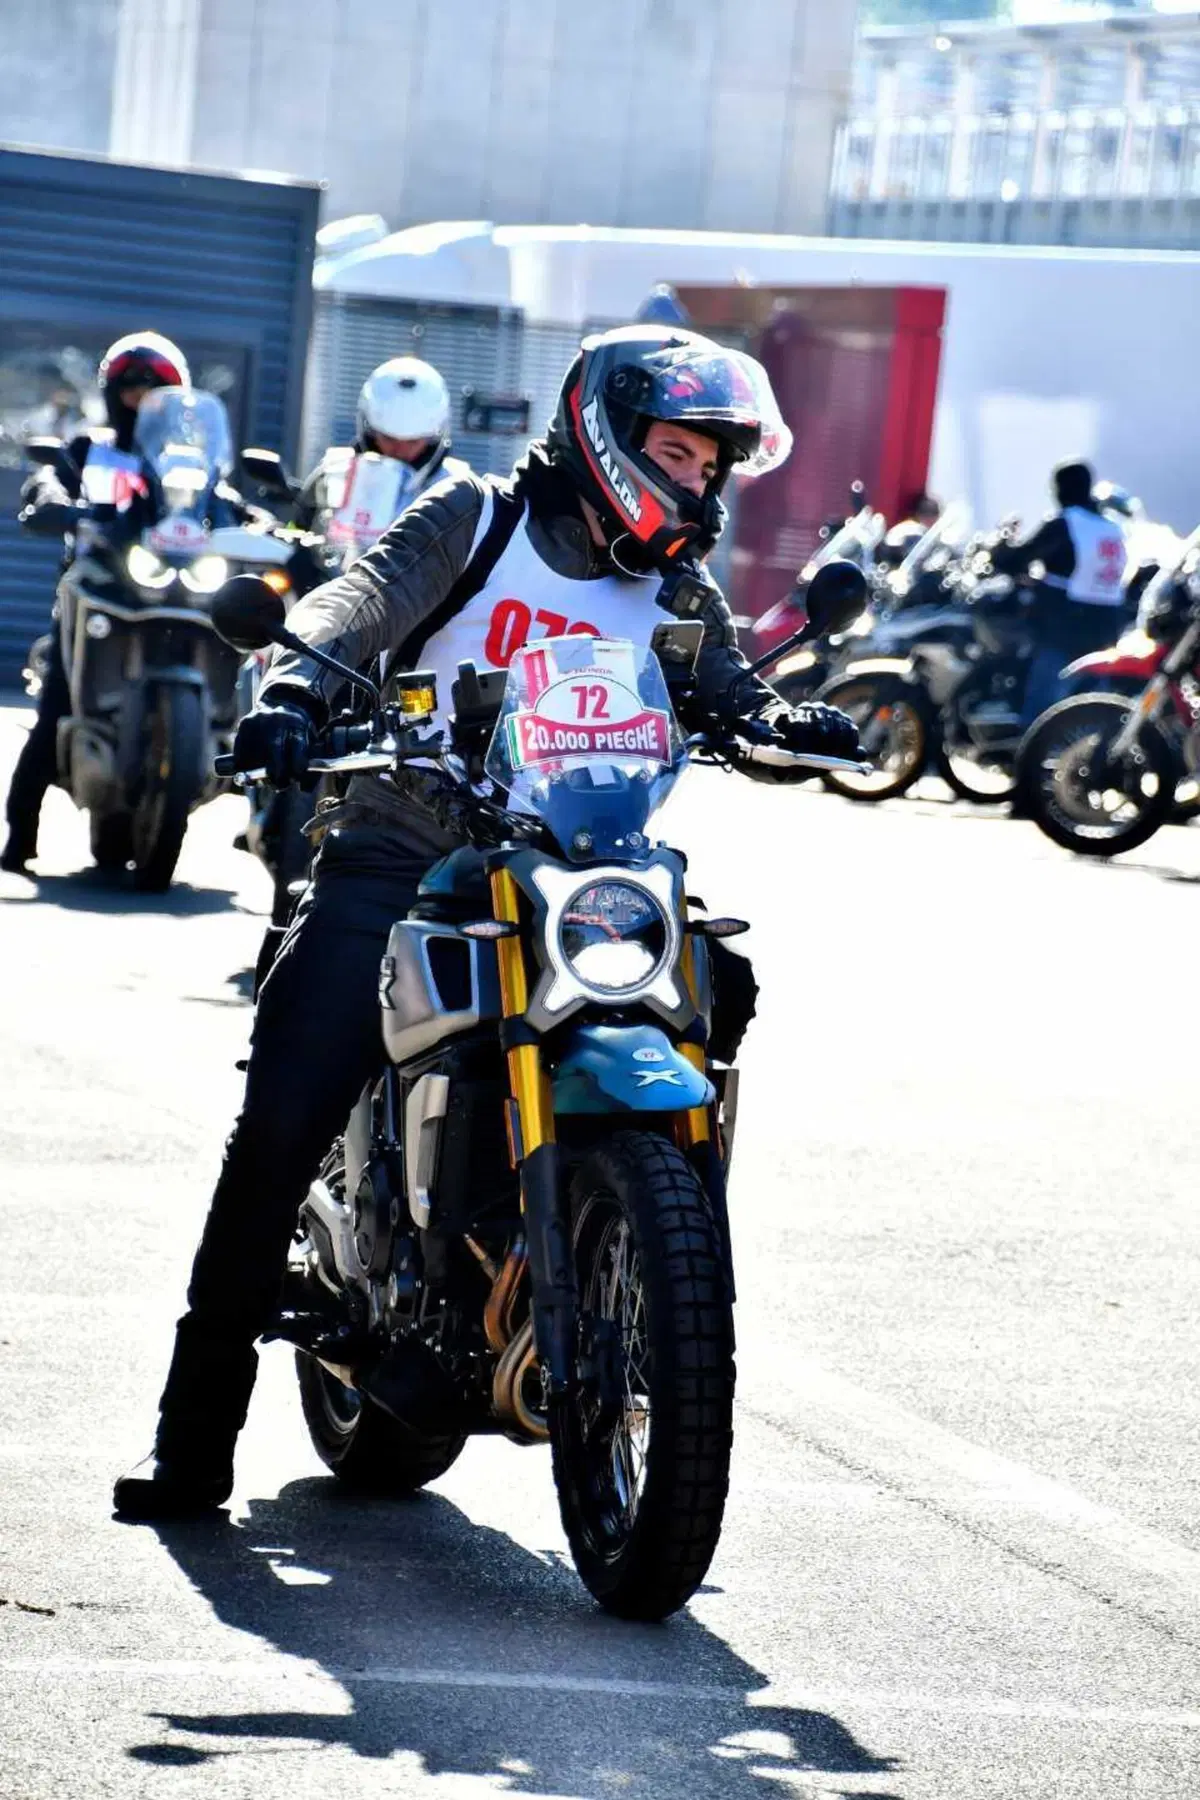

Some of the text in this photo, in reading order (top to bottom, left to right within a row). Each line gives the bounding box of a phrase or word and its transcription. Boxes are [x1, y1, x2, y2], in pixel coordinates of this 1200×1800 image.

[581, 394, 642, 522] AVALON
[570, 685, 610, 719] 72
[524, 718, 659, 750] 20.000 PIEGHE
